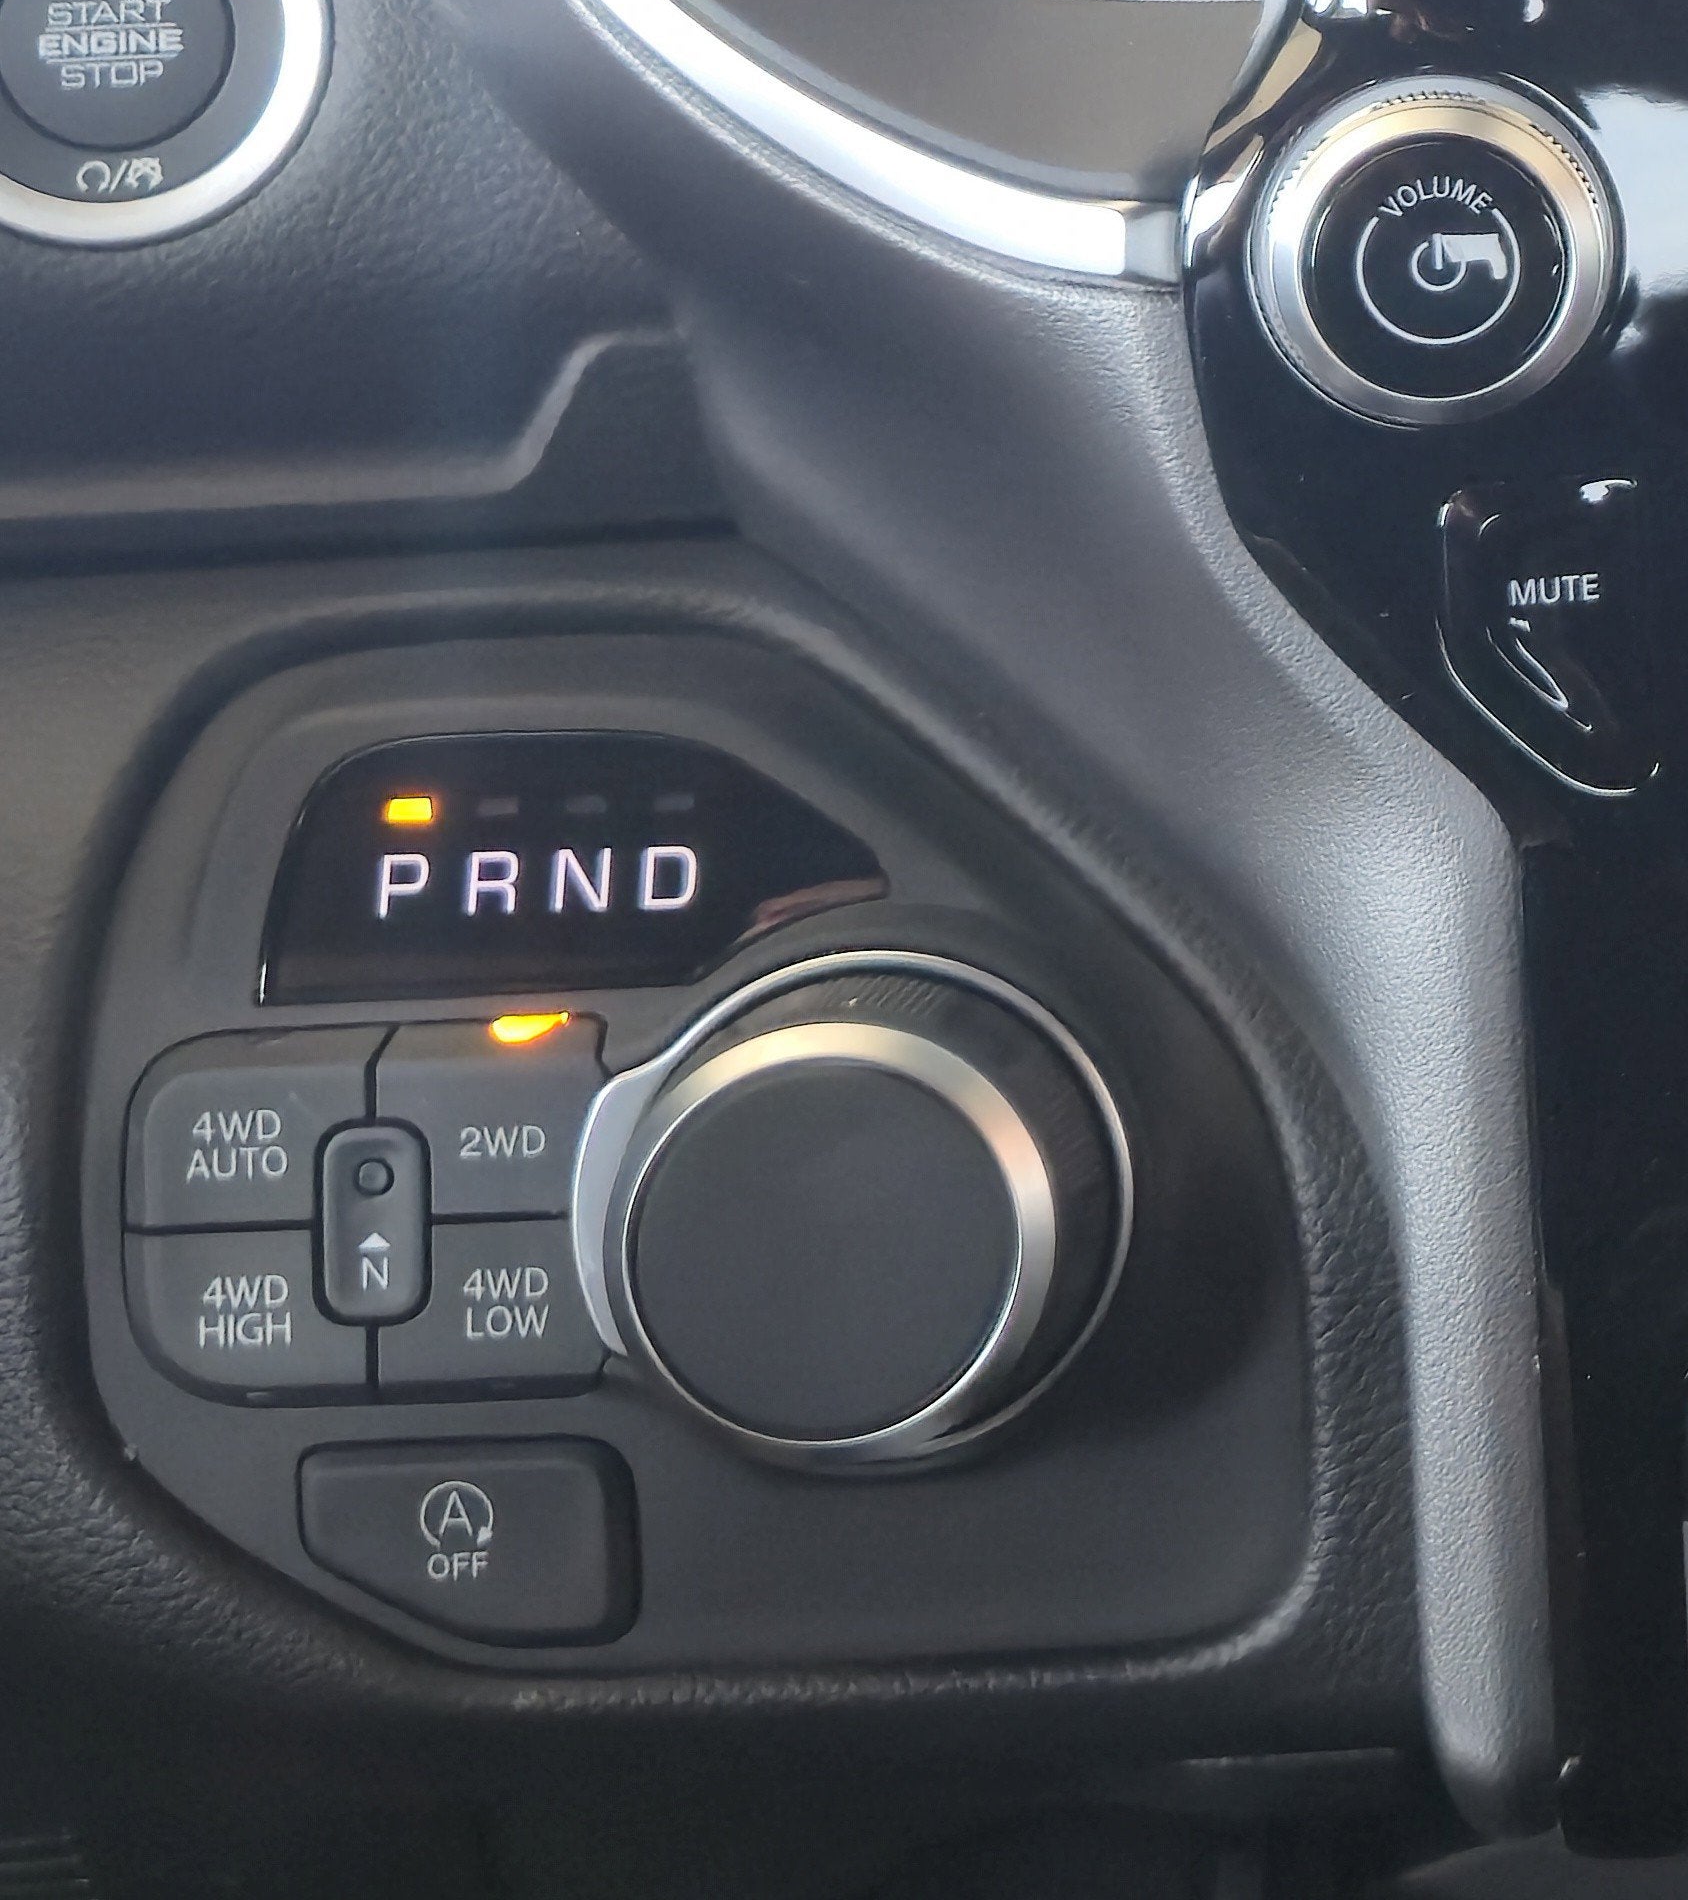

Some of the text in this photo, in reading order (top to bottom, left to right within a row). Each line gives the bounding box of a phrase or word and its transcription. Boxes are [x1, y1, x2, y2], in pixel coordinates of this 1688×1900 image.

[38, 27, 184, 57] ENGINE
[60, 59, 165, 90] STOP
[1379, 175, 1494, 218] VOLUME
[1509, 574, 1600, 605] MUTE
[378, 845, 698, 917] P R N D
[192, 1109, 281, 1141] 4WD
[459, 1125, 546, 1158] 2WD
[186, 1145, 288, 1183] AUTO
[360, 1256, 389, 1291] N
[462, 1267, 549, 1301] 4WD
[202, 1274, 289, 1310] 4WD
[199, 1311, 292, 1349] HIGH
[466, 1304, 549, 1339] LOW
[427, 1551, 489, 1580] OFF
